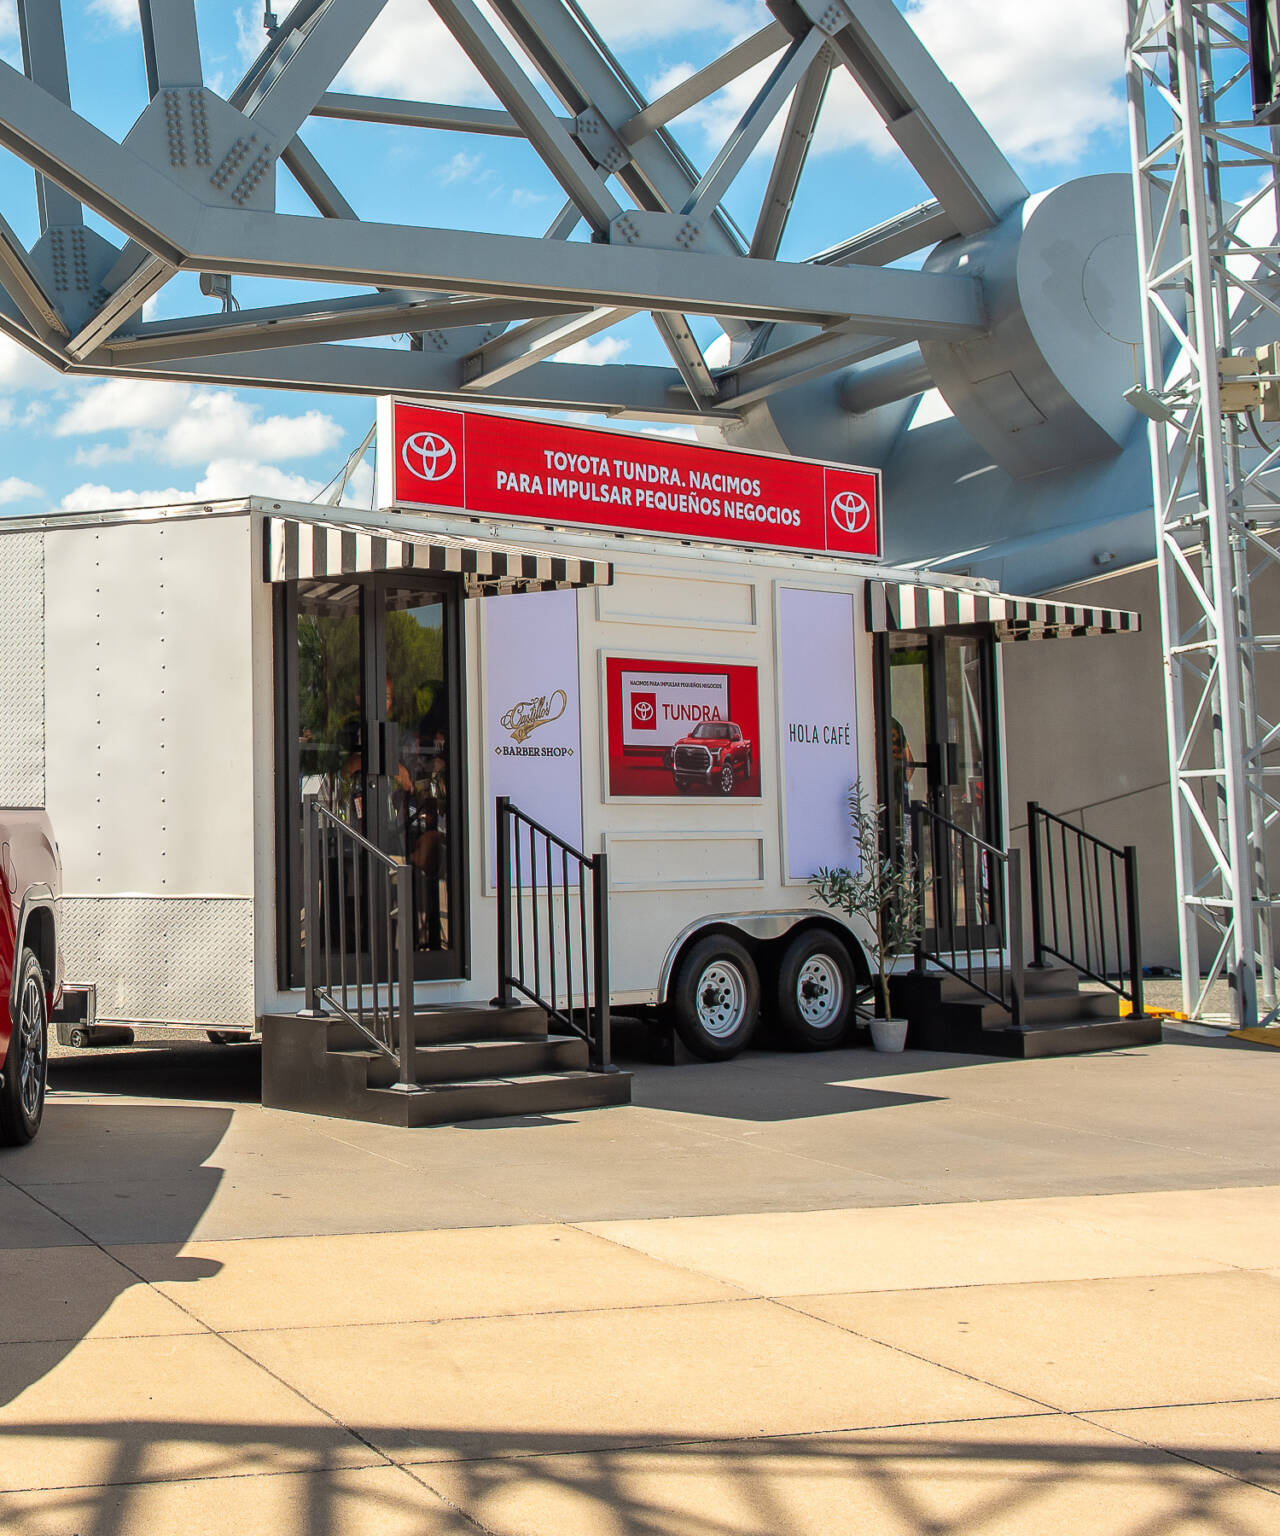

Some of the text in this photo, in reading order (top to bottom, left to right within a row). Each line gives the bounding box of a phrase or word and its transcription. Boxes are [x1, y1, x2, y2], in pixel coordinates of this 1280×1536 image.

[544, 450, 761, 497] TOYOTA TUNDRA. NACIMOS
[496, 470, 801, 527] PARA IMPULSAR PEQUEÑOS NEGOCIOS
[662, 703, 720, 721] TUNDRA
[789, 723, 850, 745] HOLA CAFÉ
[503, 746, 567, 757] BARBER SHOP
